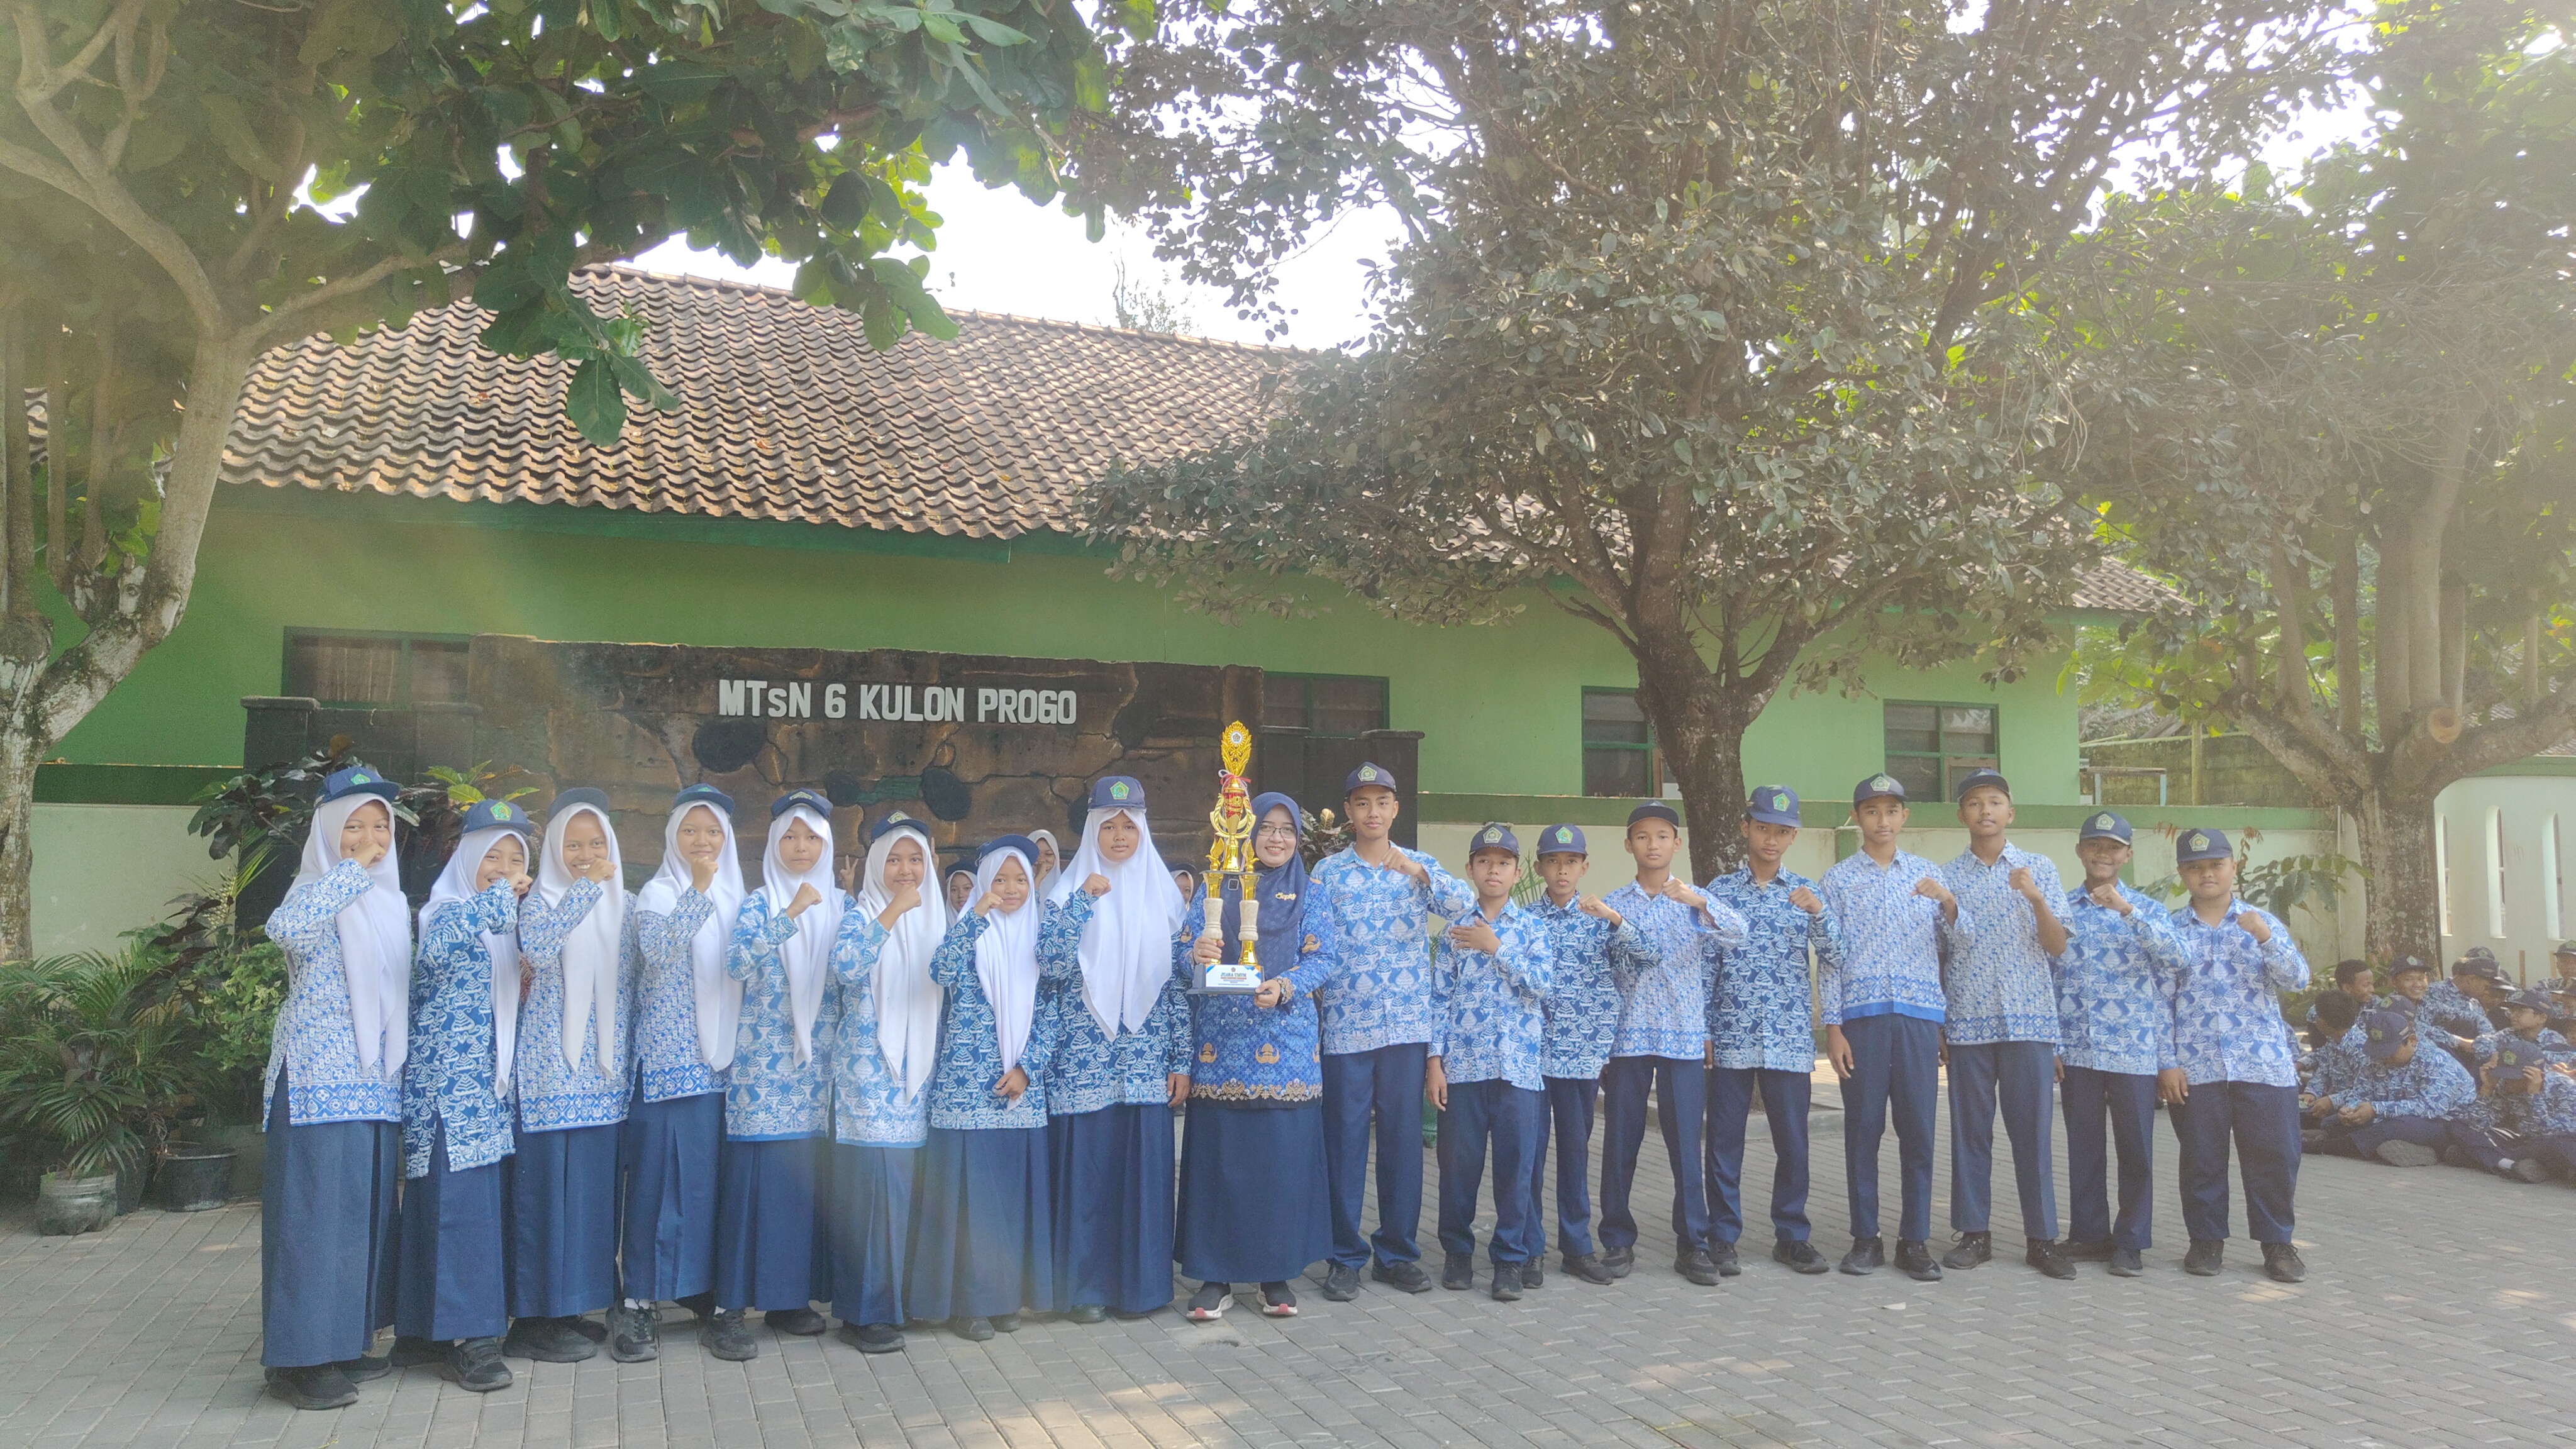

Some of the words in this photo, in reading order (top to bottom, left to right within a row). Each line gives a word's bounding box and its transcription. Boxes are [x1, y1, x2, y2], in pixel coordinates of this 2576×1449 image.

[719, 679, 811, 718] MTsN
[824, 684, 847, 719] 6
[860, 684, 965, 722] KULON
[978, 688, 1077, 724] PROGO
